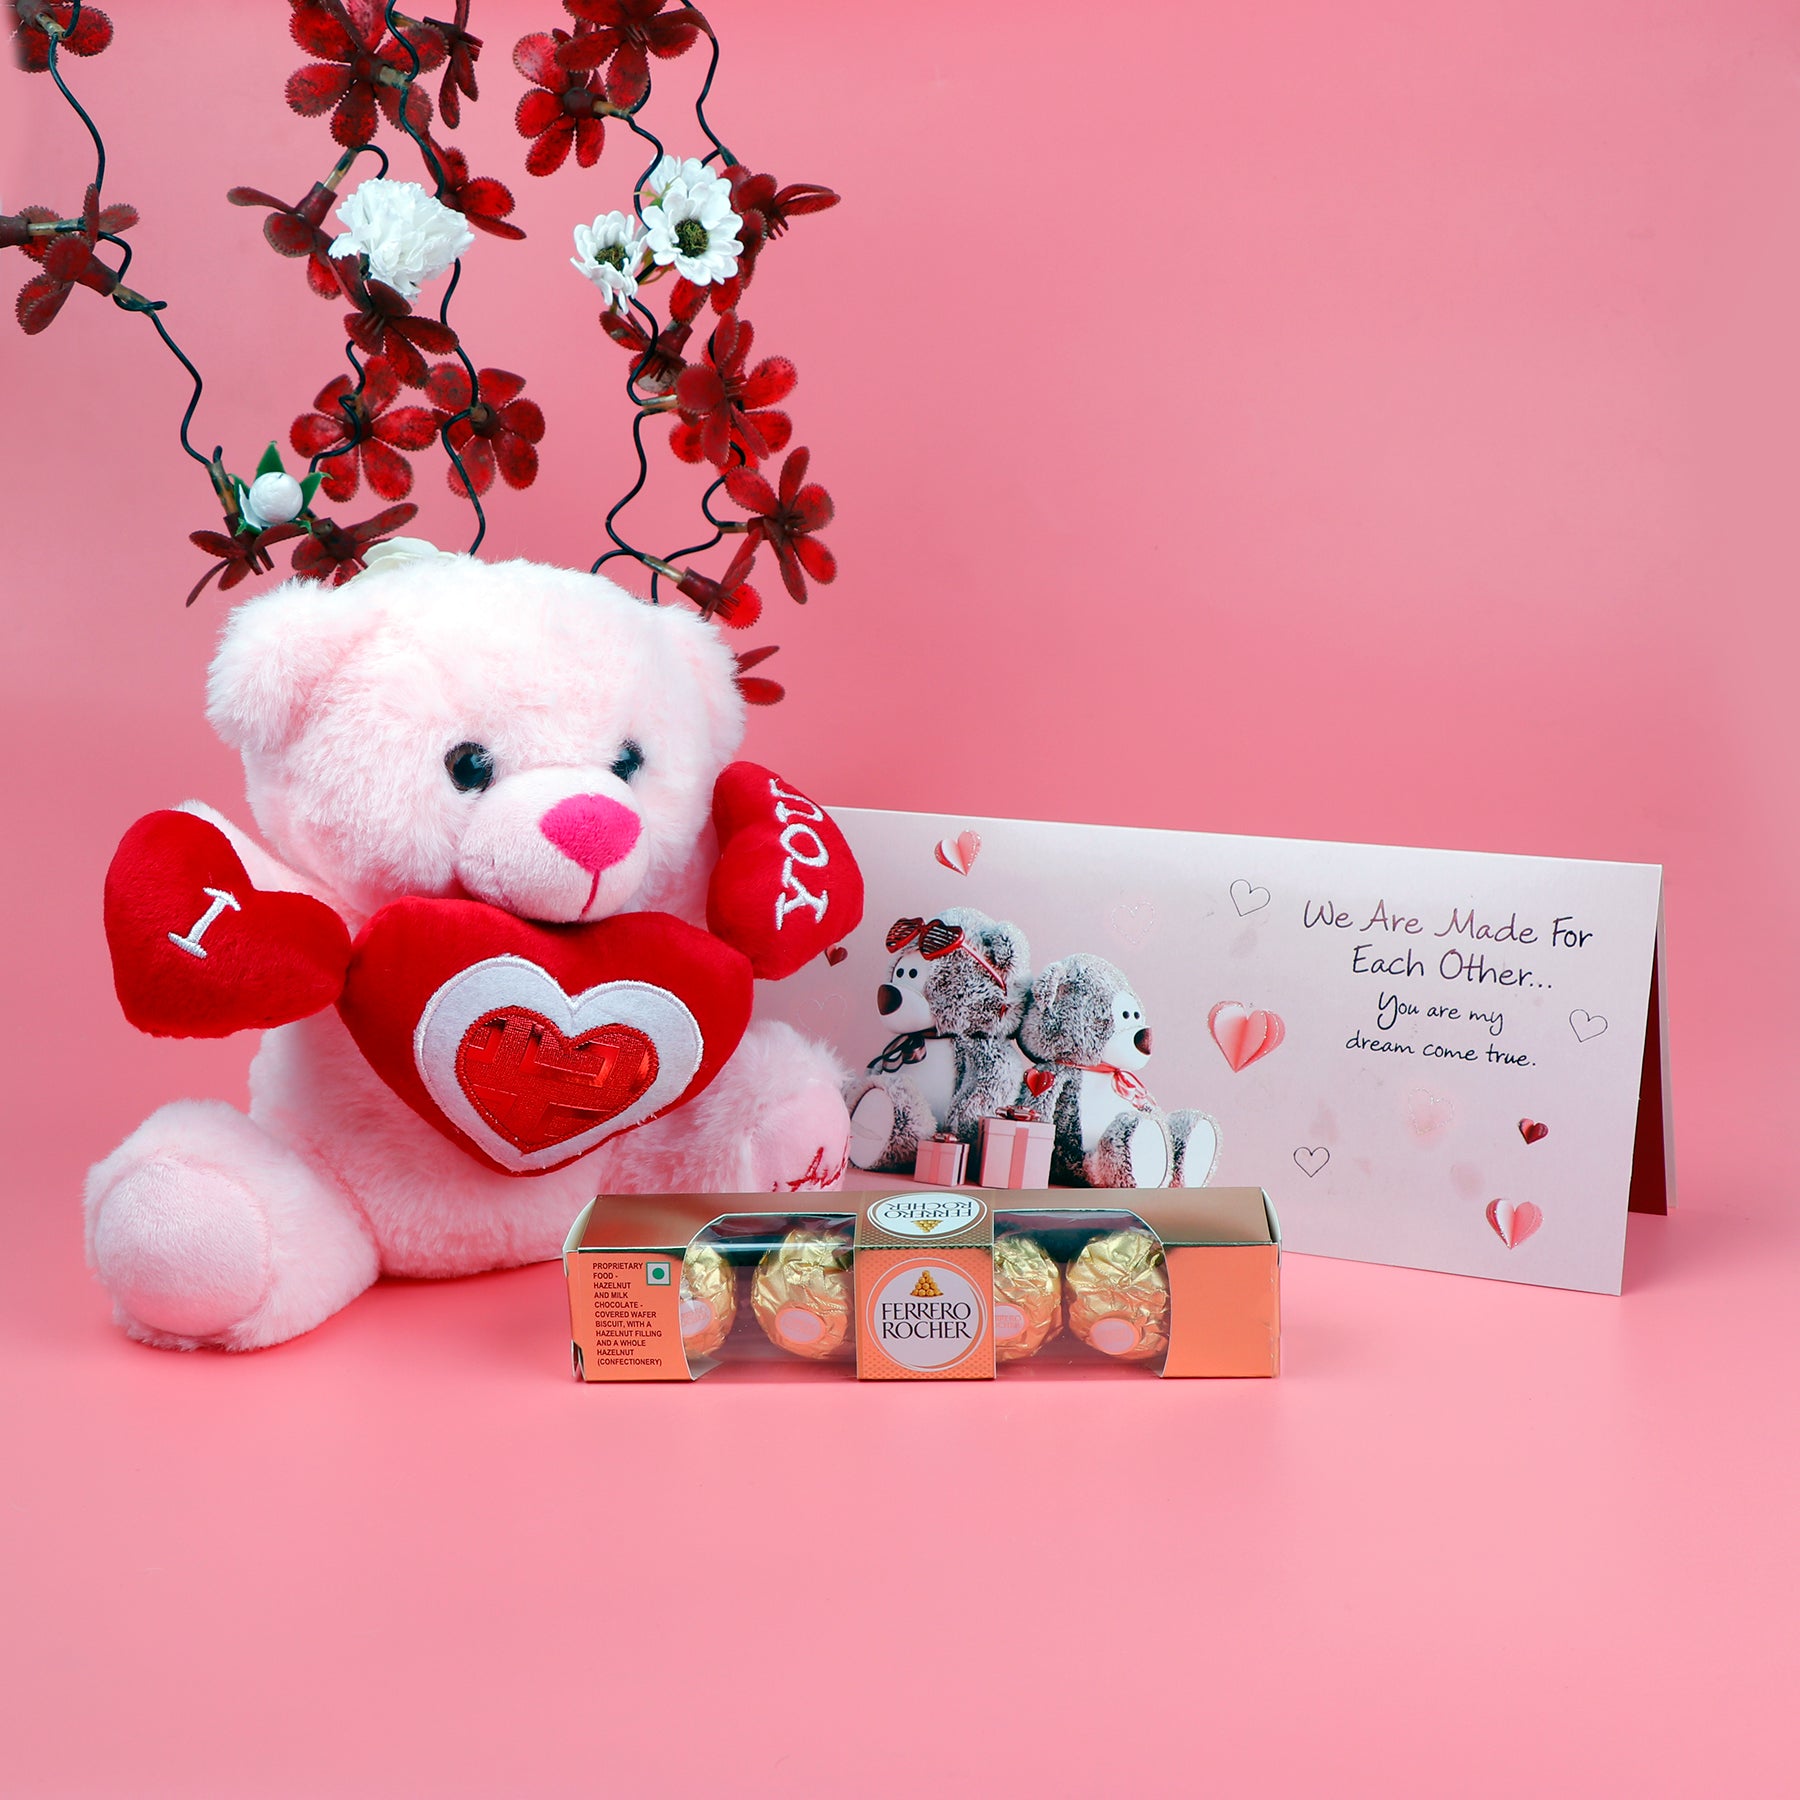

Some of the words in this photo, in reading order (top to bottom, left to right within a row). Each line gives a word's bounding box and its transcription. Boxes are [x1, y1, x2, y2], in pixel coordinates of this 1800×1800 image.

[768, 777, 830, 931] YOU
[167, 886, 242, 959] I
[1303, 899, 1354, 929] We
[1359, 899, 1423, 934] Are
[1434, 907, 1538, 945] Made
[1552, 916, 1593, 949] For
[1352, 944, 1425, 978] Each
[1439, 948, 1553, 989] Other...
[1377, 991, 1420, 1030] You
[1427, 1006, 1461, 1020] are
[1469, 1010, 1504, 1036] my
[1345, 1029, 1414, 1055] dream
[1422, 1043, 1478, 1061] come
[1486, 1043, 1536, 1067] true.
[886, 1201, 972, 1210] ROCHER
[884, 1209, 972, 1219] FERRERO
[592, 1262, 644, 1270] PROPRIETARY
[594, 1291, 610, 1299] AND
[611, 1291, 628, 1299] MILK
[594, 1301, 639, 1309] CHOCOLATE
[882, 1302, 971, 1321] FERRERO
[595, 1320, 625, 1328] BISCUIT,
[627, 1320, 645, 1328] WITH
[646, 1320, 652, 1328] A
[882, 1321, 972, 1339] ROCHER
[620, 1339, 646, 1347] WHOLE
[597, 1358, 662, 1366] (CONFECTIONERY)
